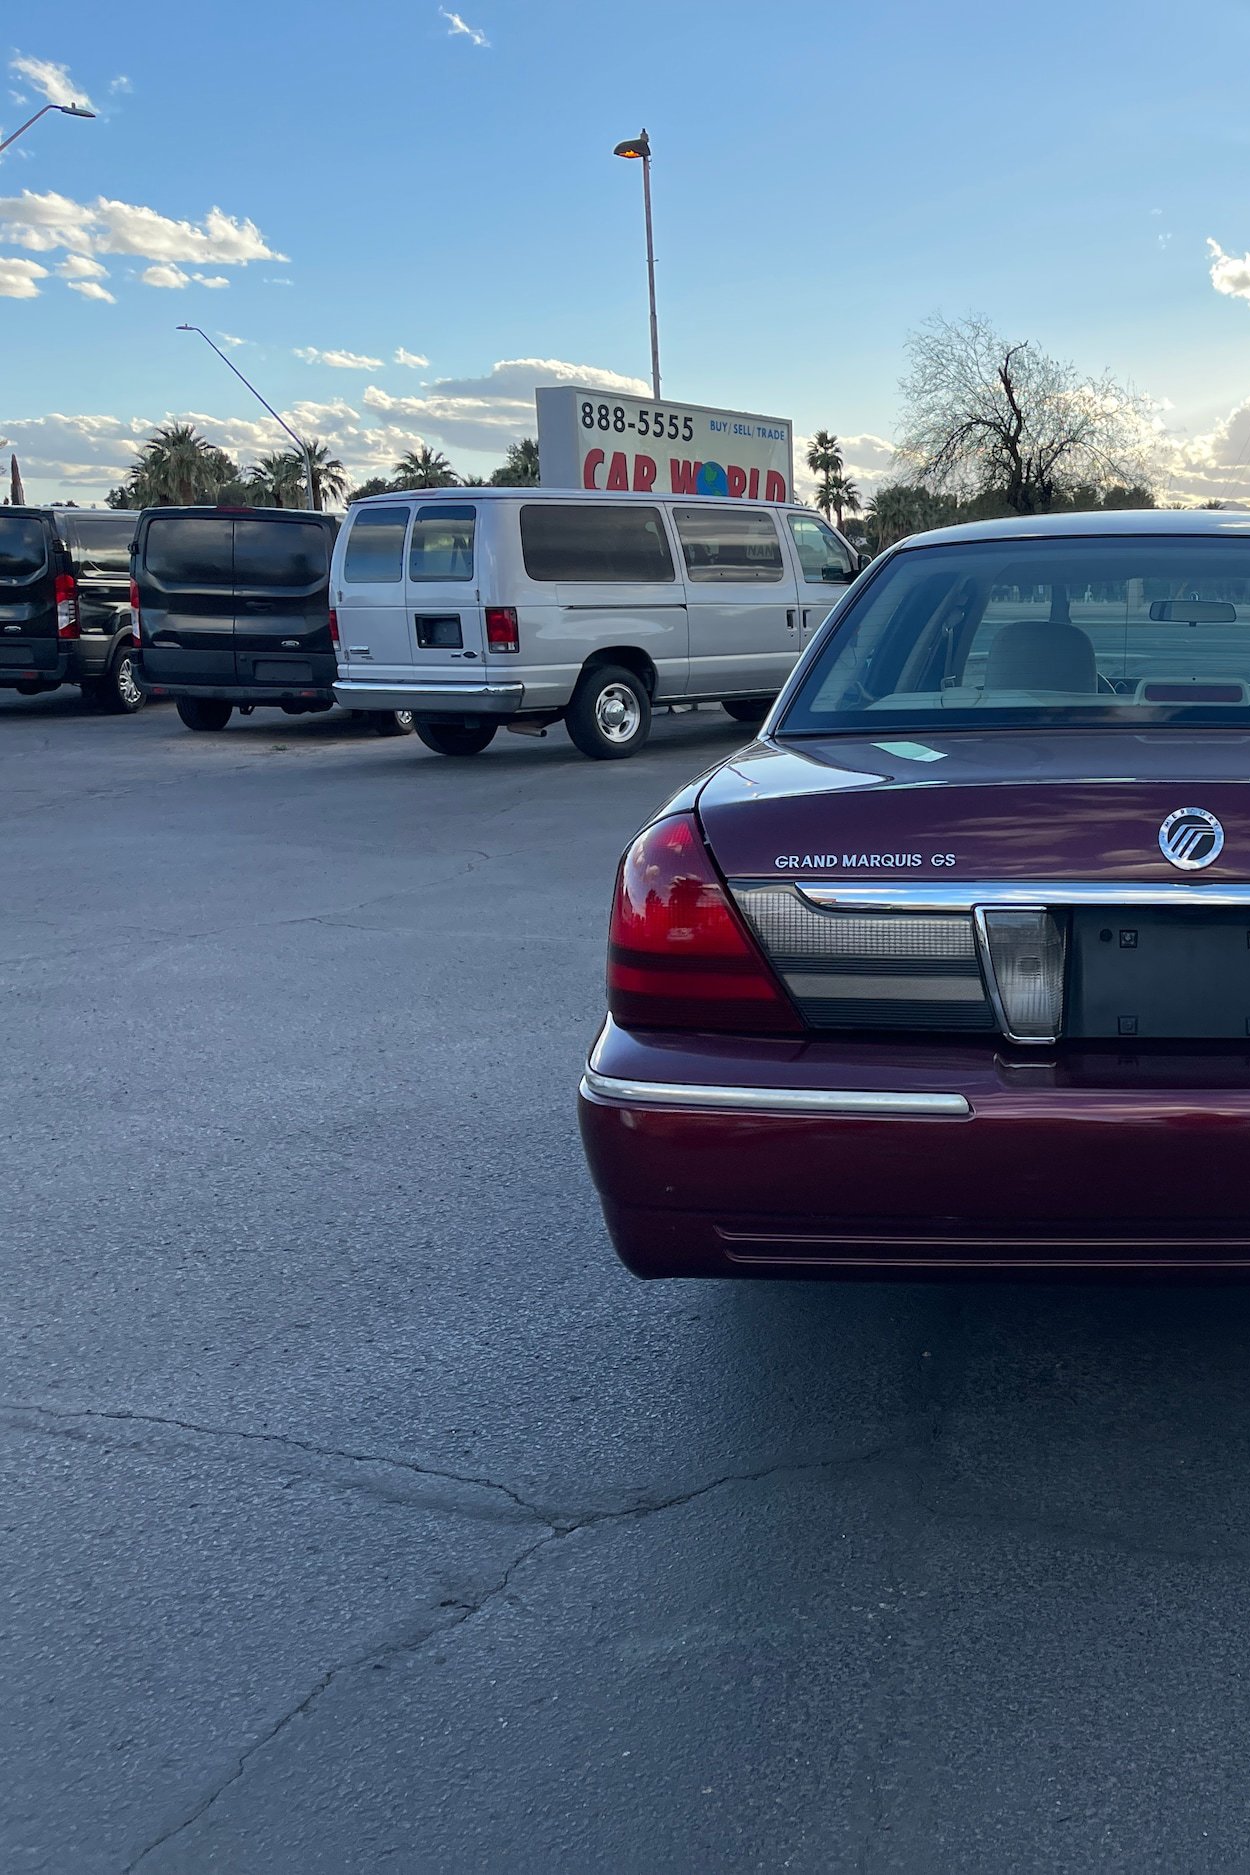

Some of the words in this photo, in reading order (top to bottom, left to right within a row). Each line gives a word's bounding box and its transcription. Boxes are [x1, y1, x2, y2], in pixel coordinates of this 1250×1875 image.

[581, 401, 694, 442] 888-5555
[583, 448, 657, 492] CAR
[774, 853, 838, 869] GRAND
[842, 853, 923, 869] MARQUIS
[930, 853, 956, 867] GS
